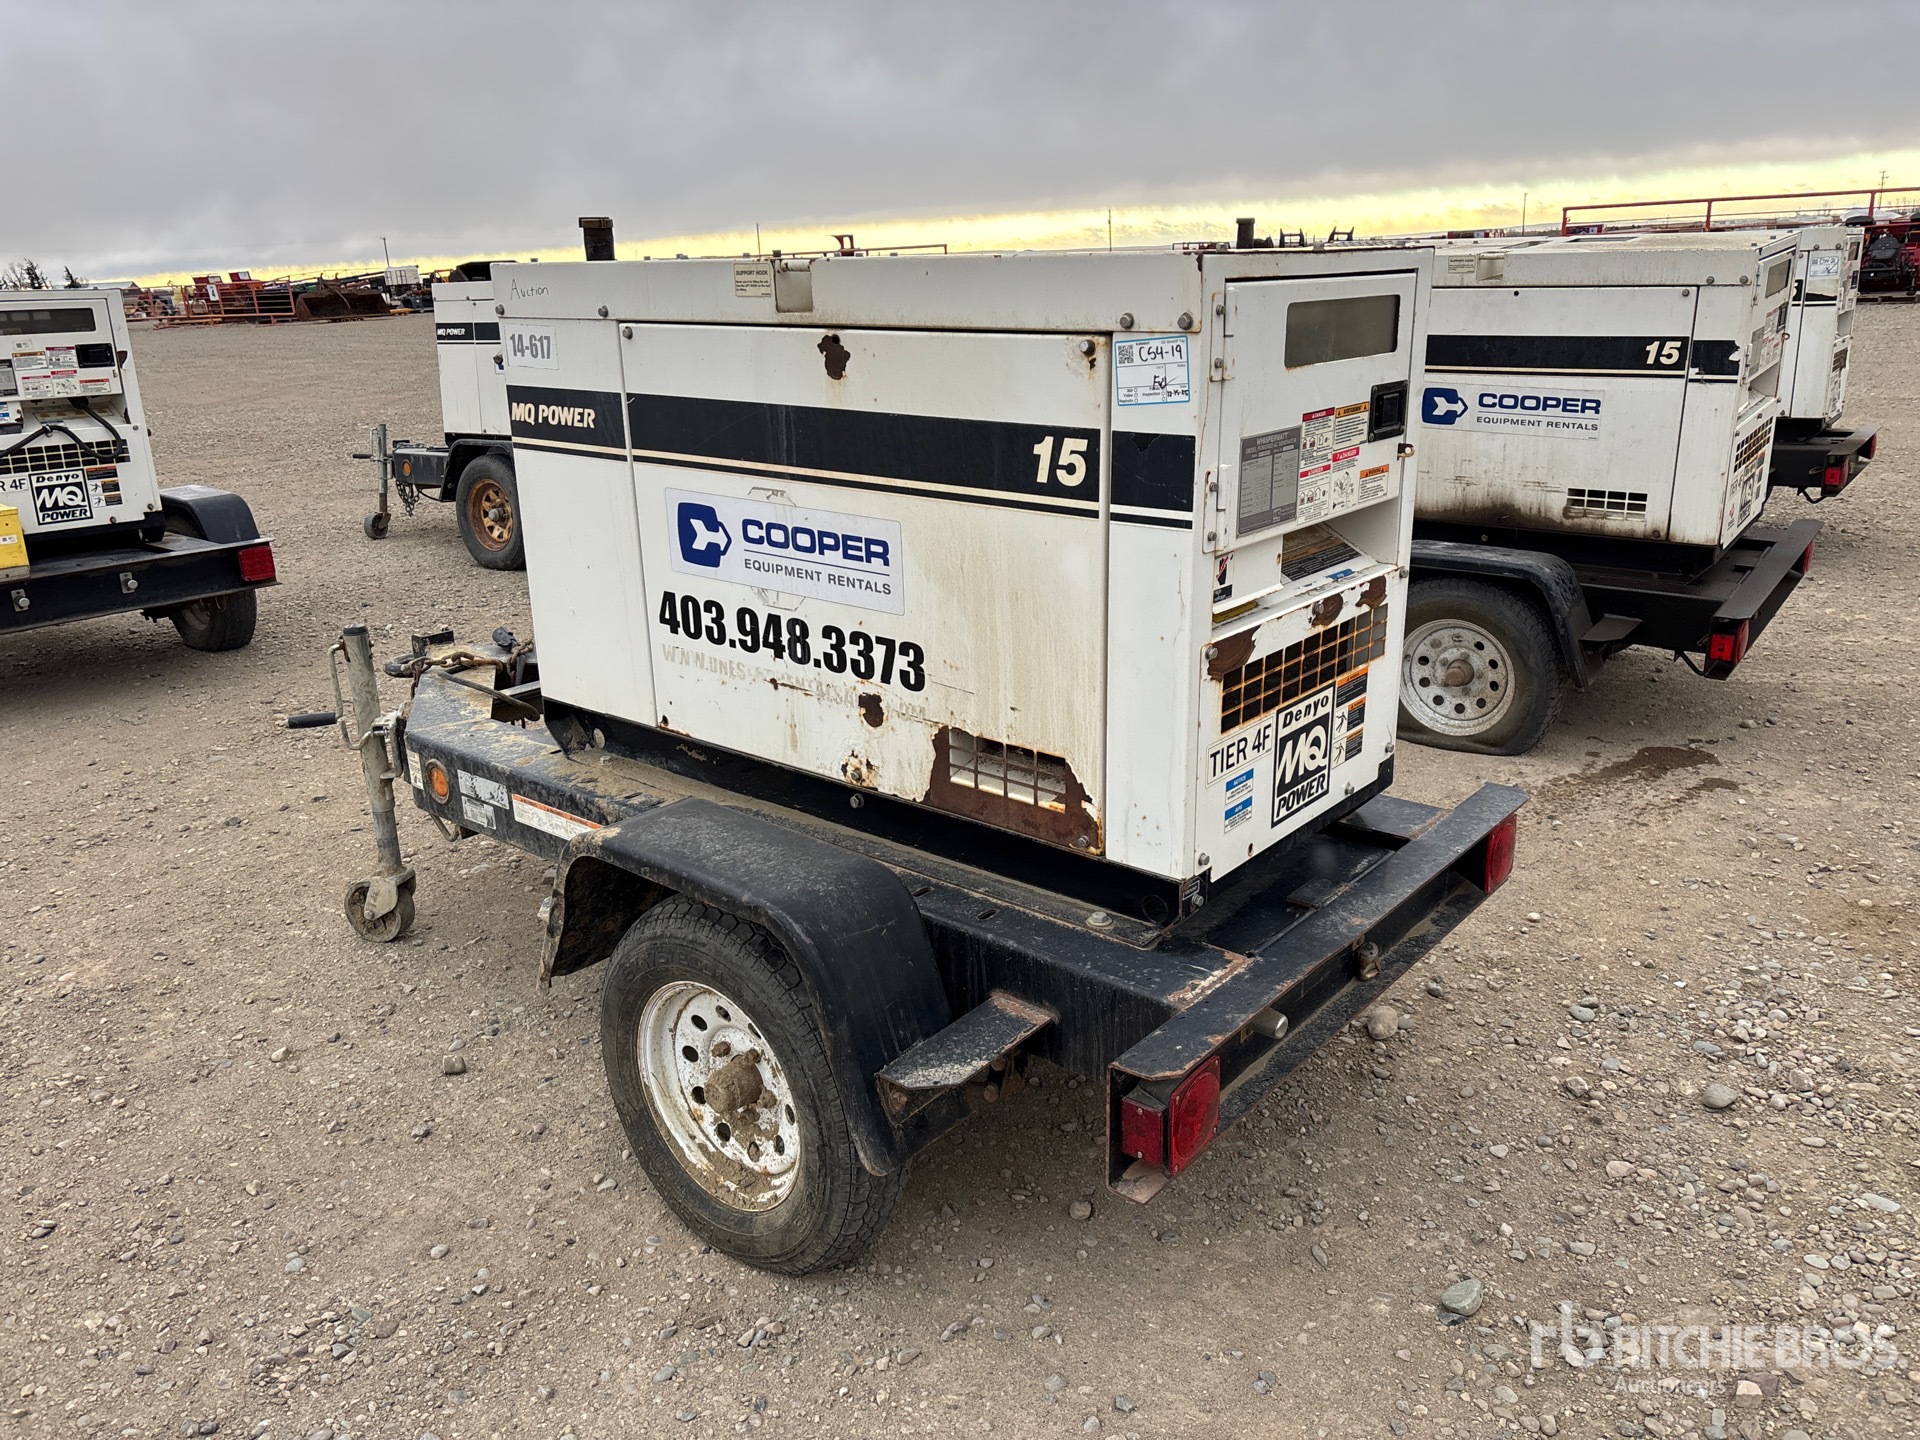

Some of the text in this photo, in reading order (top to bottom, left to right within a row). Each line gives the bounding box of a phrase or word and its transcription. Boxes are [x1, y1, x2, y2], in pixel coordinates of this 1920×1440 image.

[510, 279, 550, 301] Auction
[446, 328, 466, 336] POWER
[510, 333, 551, 360] 14-617
[1645, 340, 1682, 365] 15
[511, 402, 596, 429] MQ POWER
[1478, 393, 1601, 415] COOPER
[1476, 416, 1599, 432] EQUIPMENT RENTALS
[1032, 435, 1088, 487] 15
[10, 478, 26, 490] 4F
[36, 473, 79, 483] Denyo
[37, 486, 86, 508] MQ
[41, 508, 88, 522] POWER
[741, 518, 890, 567] COOPER
[744, 558, 892, 595] EQUIPMENT RENTALS
[659, 590, 926, 692] 403.948.3373
[1282, 695, 1329, 730] Denyo
[1210, 723, 1272, 777] TIER 4F
[1277, 725, 1328, 786] MQ
[1275, 773, 1325, 819] POWER
